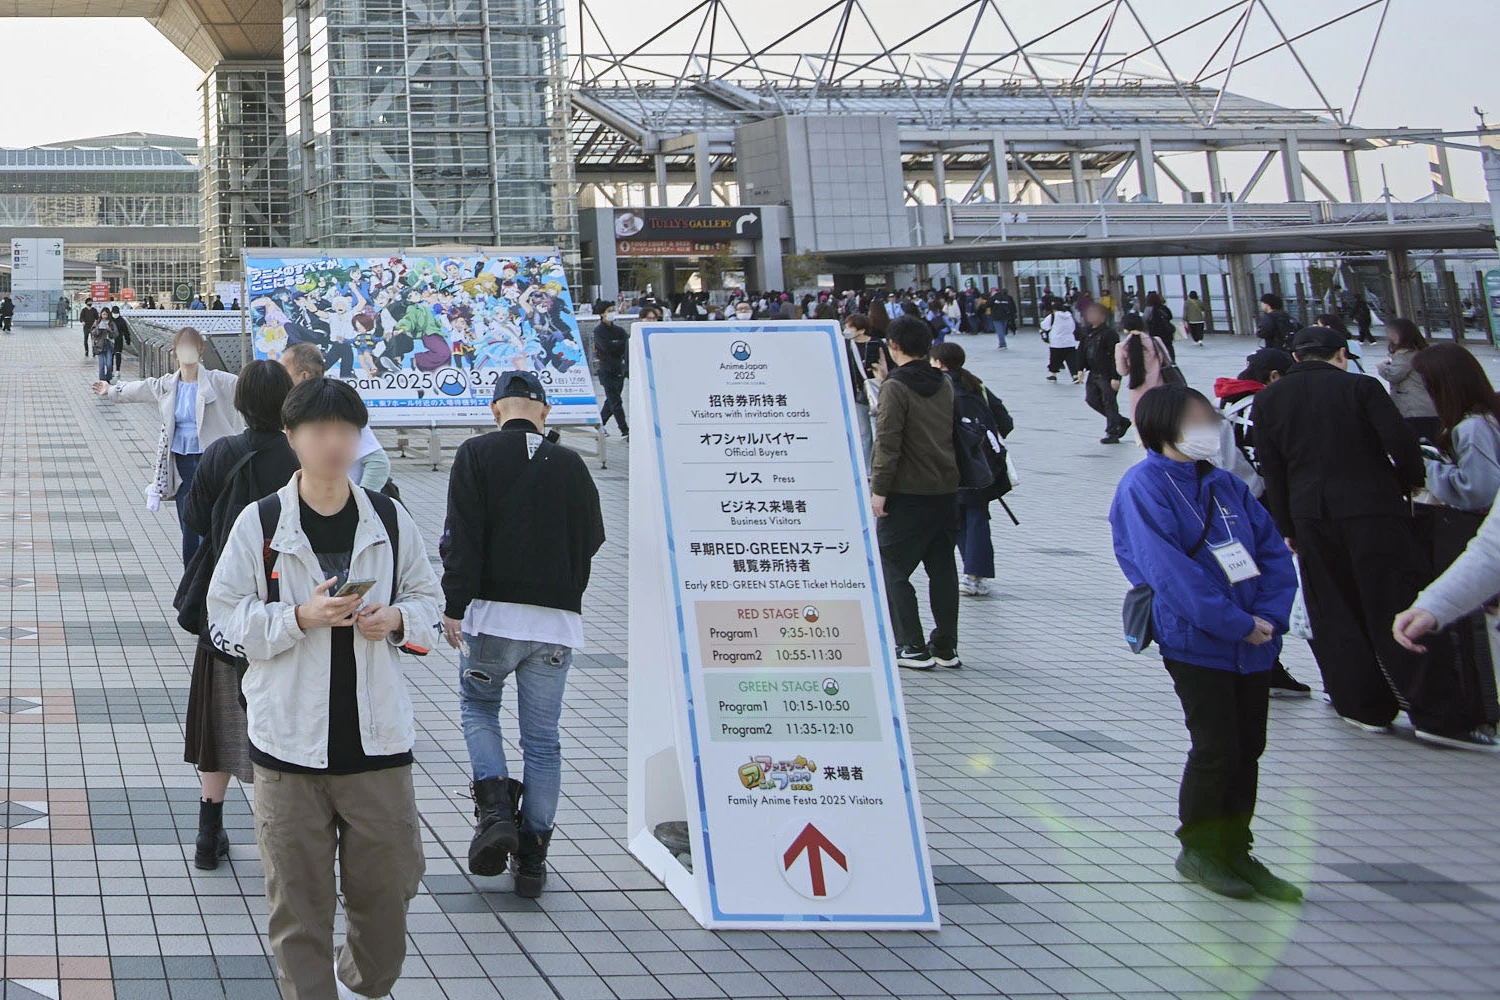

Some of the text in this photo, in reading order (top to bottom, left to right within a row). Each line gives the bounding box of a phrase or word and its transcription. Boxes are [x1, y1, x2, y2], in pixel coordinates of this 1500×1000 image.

[689, 219, 732, 229] GALLERY
[251, 259, 342, 280] アニメのすべてが、
[251, 274, 311, 291] ここにある。
[720, 362, 768, 371] AnimeJapan
[384, 373, 433, 390] 2025
[734, 372, 756, 380] 2025
[709, 394, 788, 408] 招待券所持者
[691, 409, 810, 418] Visitors with invitation cards
[700, 432, 808, 446] オフシャルバイヤー
[724, 448, 788, 458] Official Buyers
[726, 472, 796, 484] プレス Press
[720, 500, 807, 514] ビジネス来場者
[730, 516, 802, 526] Business Visitors
[733, 559, 810, 573] 観覧券所持者
[1228, 560, 1246, 570] STAFF
[685, 580, 708, 592] Early
[769, 580, 800, 589] STAGE
[802, 580, 828, 589] Ticket
[831, 580, 866, 589] Holders
[738, 608, 800, 619] RED STAGE
[710, 627, 840, 641] Program1 9:35-10:10
[713, 650, 842, 664] Program2 10:55-11:30
[738, 680, 819, 692] GREEN STAGE
[719, 700, 850, 714] Program1 10:15-10:50
[722, 723, 854, 738] Program2 11:35-12:10
[823, 766, 864, 780] 来場者
[728, 794, 884, 808] Family Anime Festa 2025 Visitors
